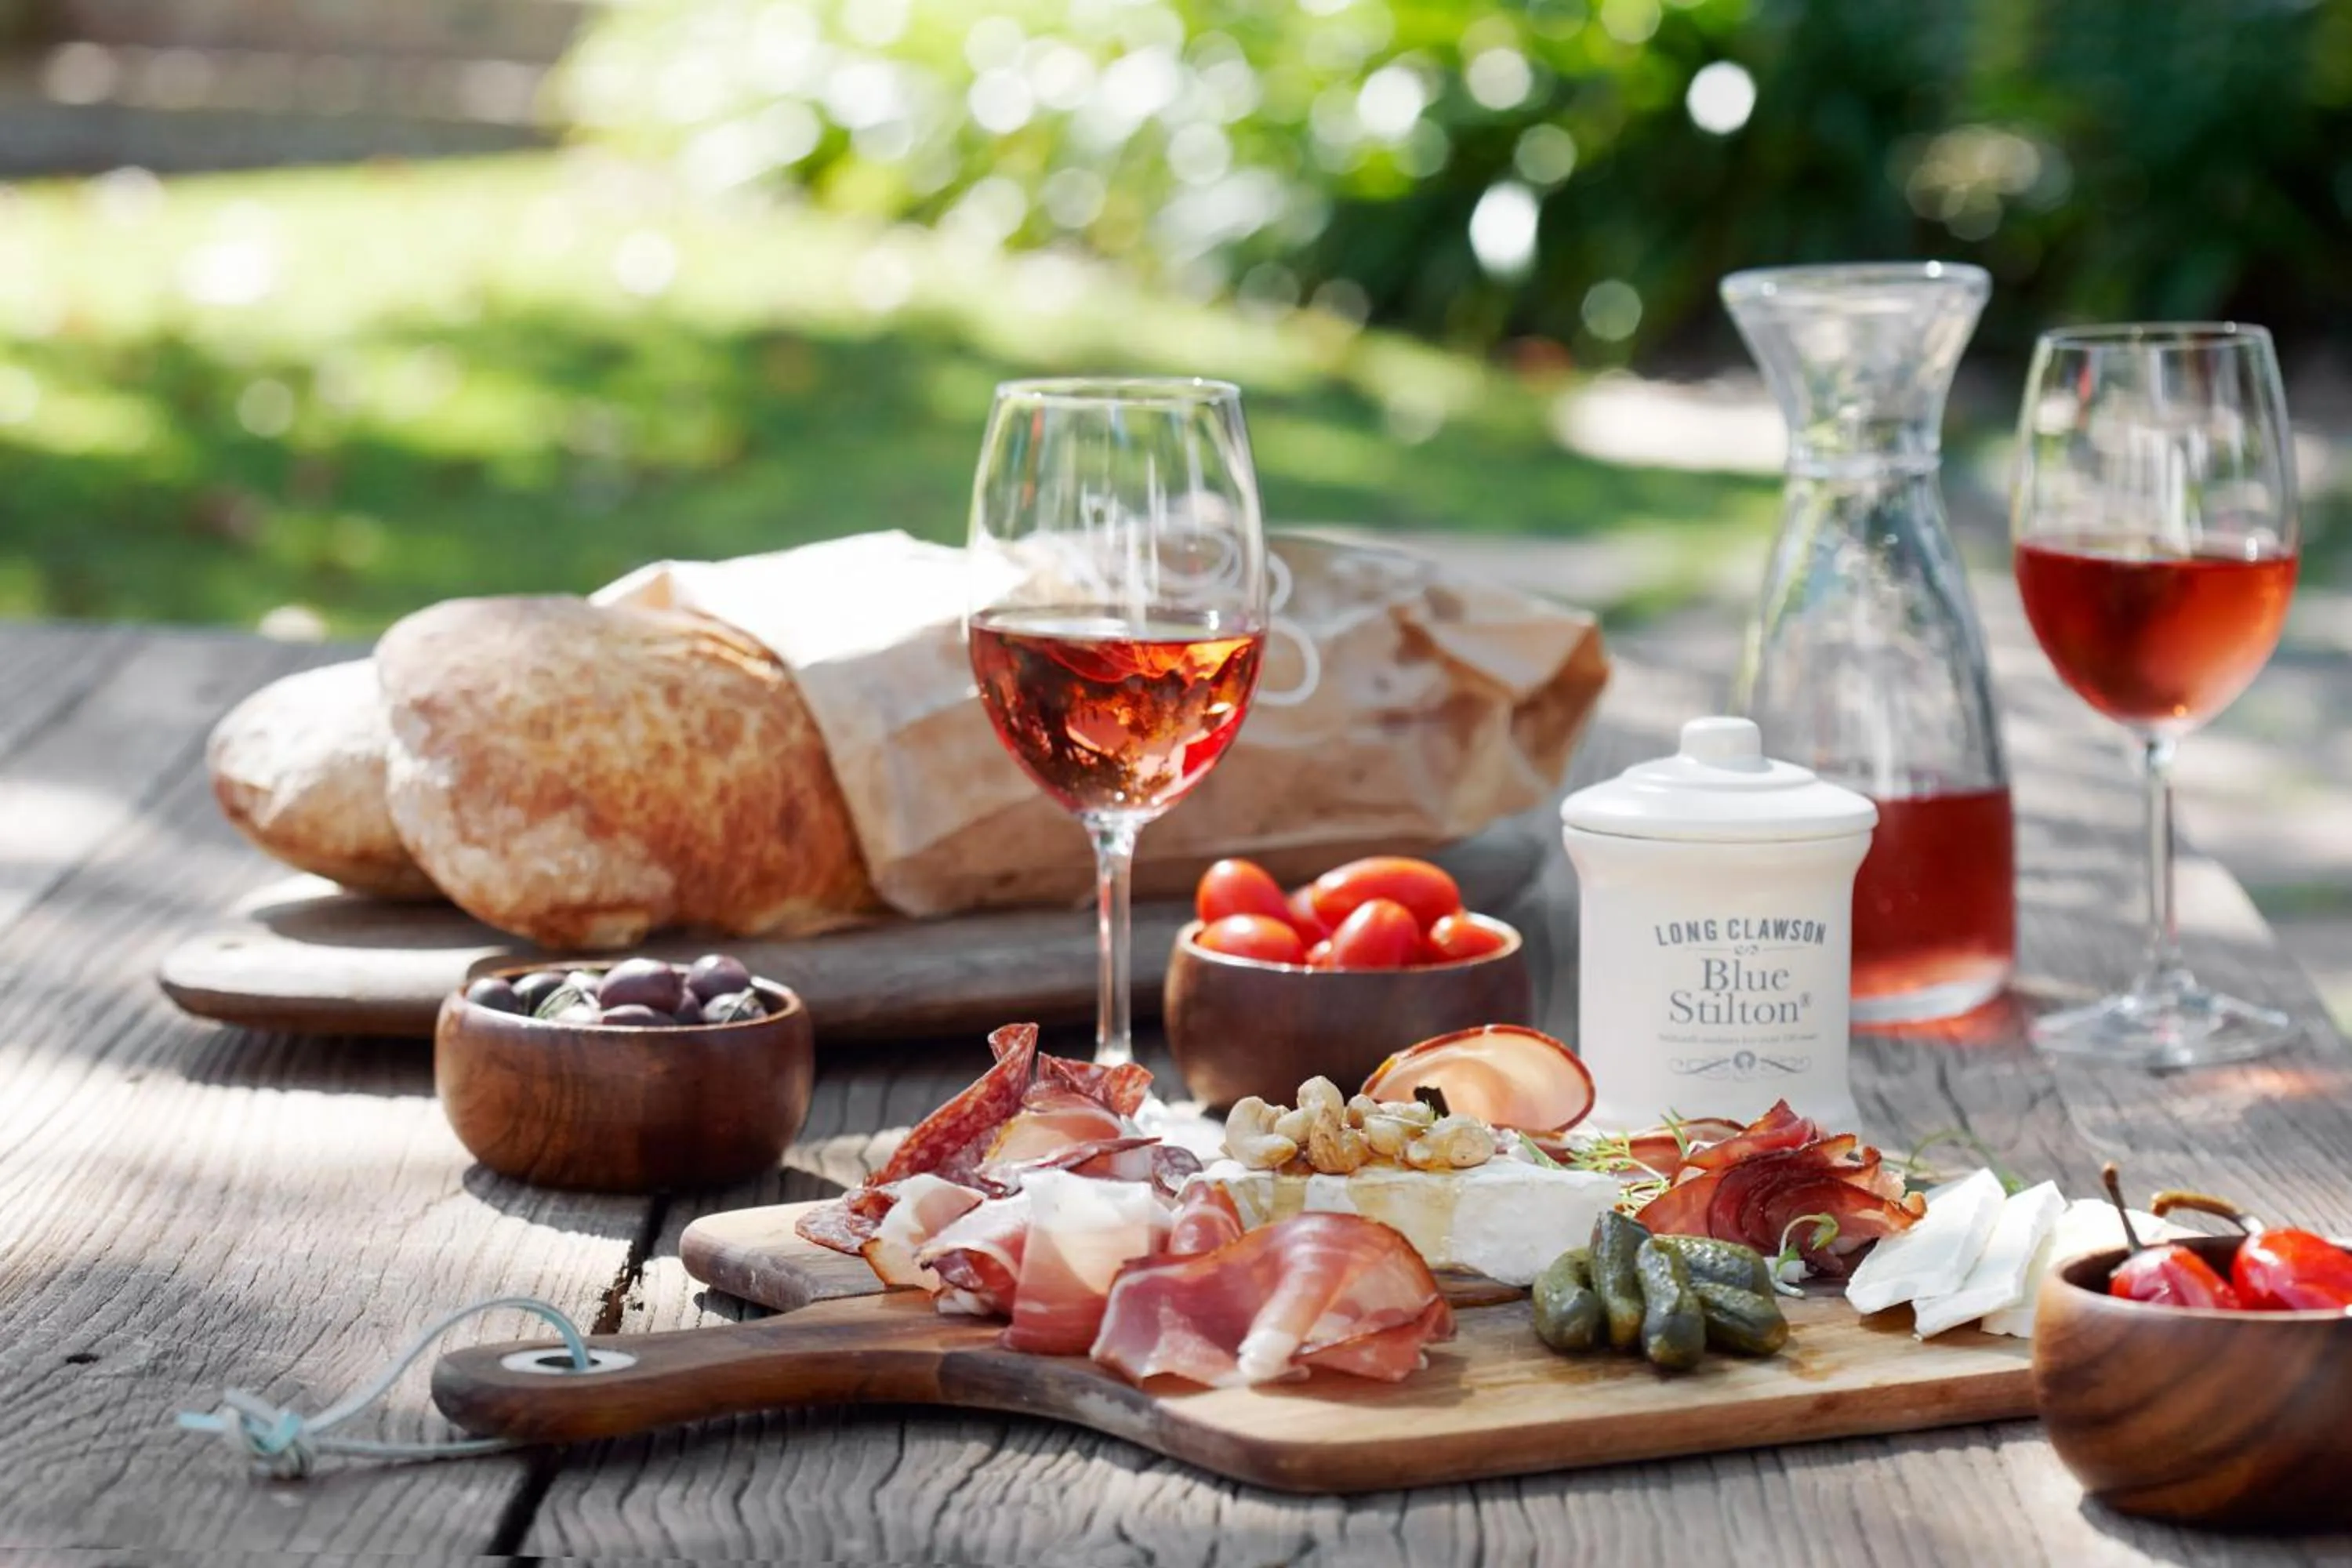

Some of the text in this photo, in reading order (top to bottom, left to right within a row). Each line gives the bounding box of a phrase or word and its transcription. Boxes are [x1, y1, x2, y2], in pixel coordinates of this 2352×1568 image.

[1654, 917, 1828, 947] LONG CLAWSON
[1700, 957, 1790, 992] Blue
